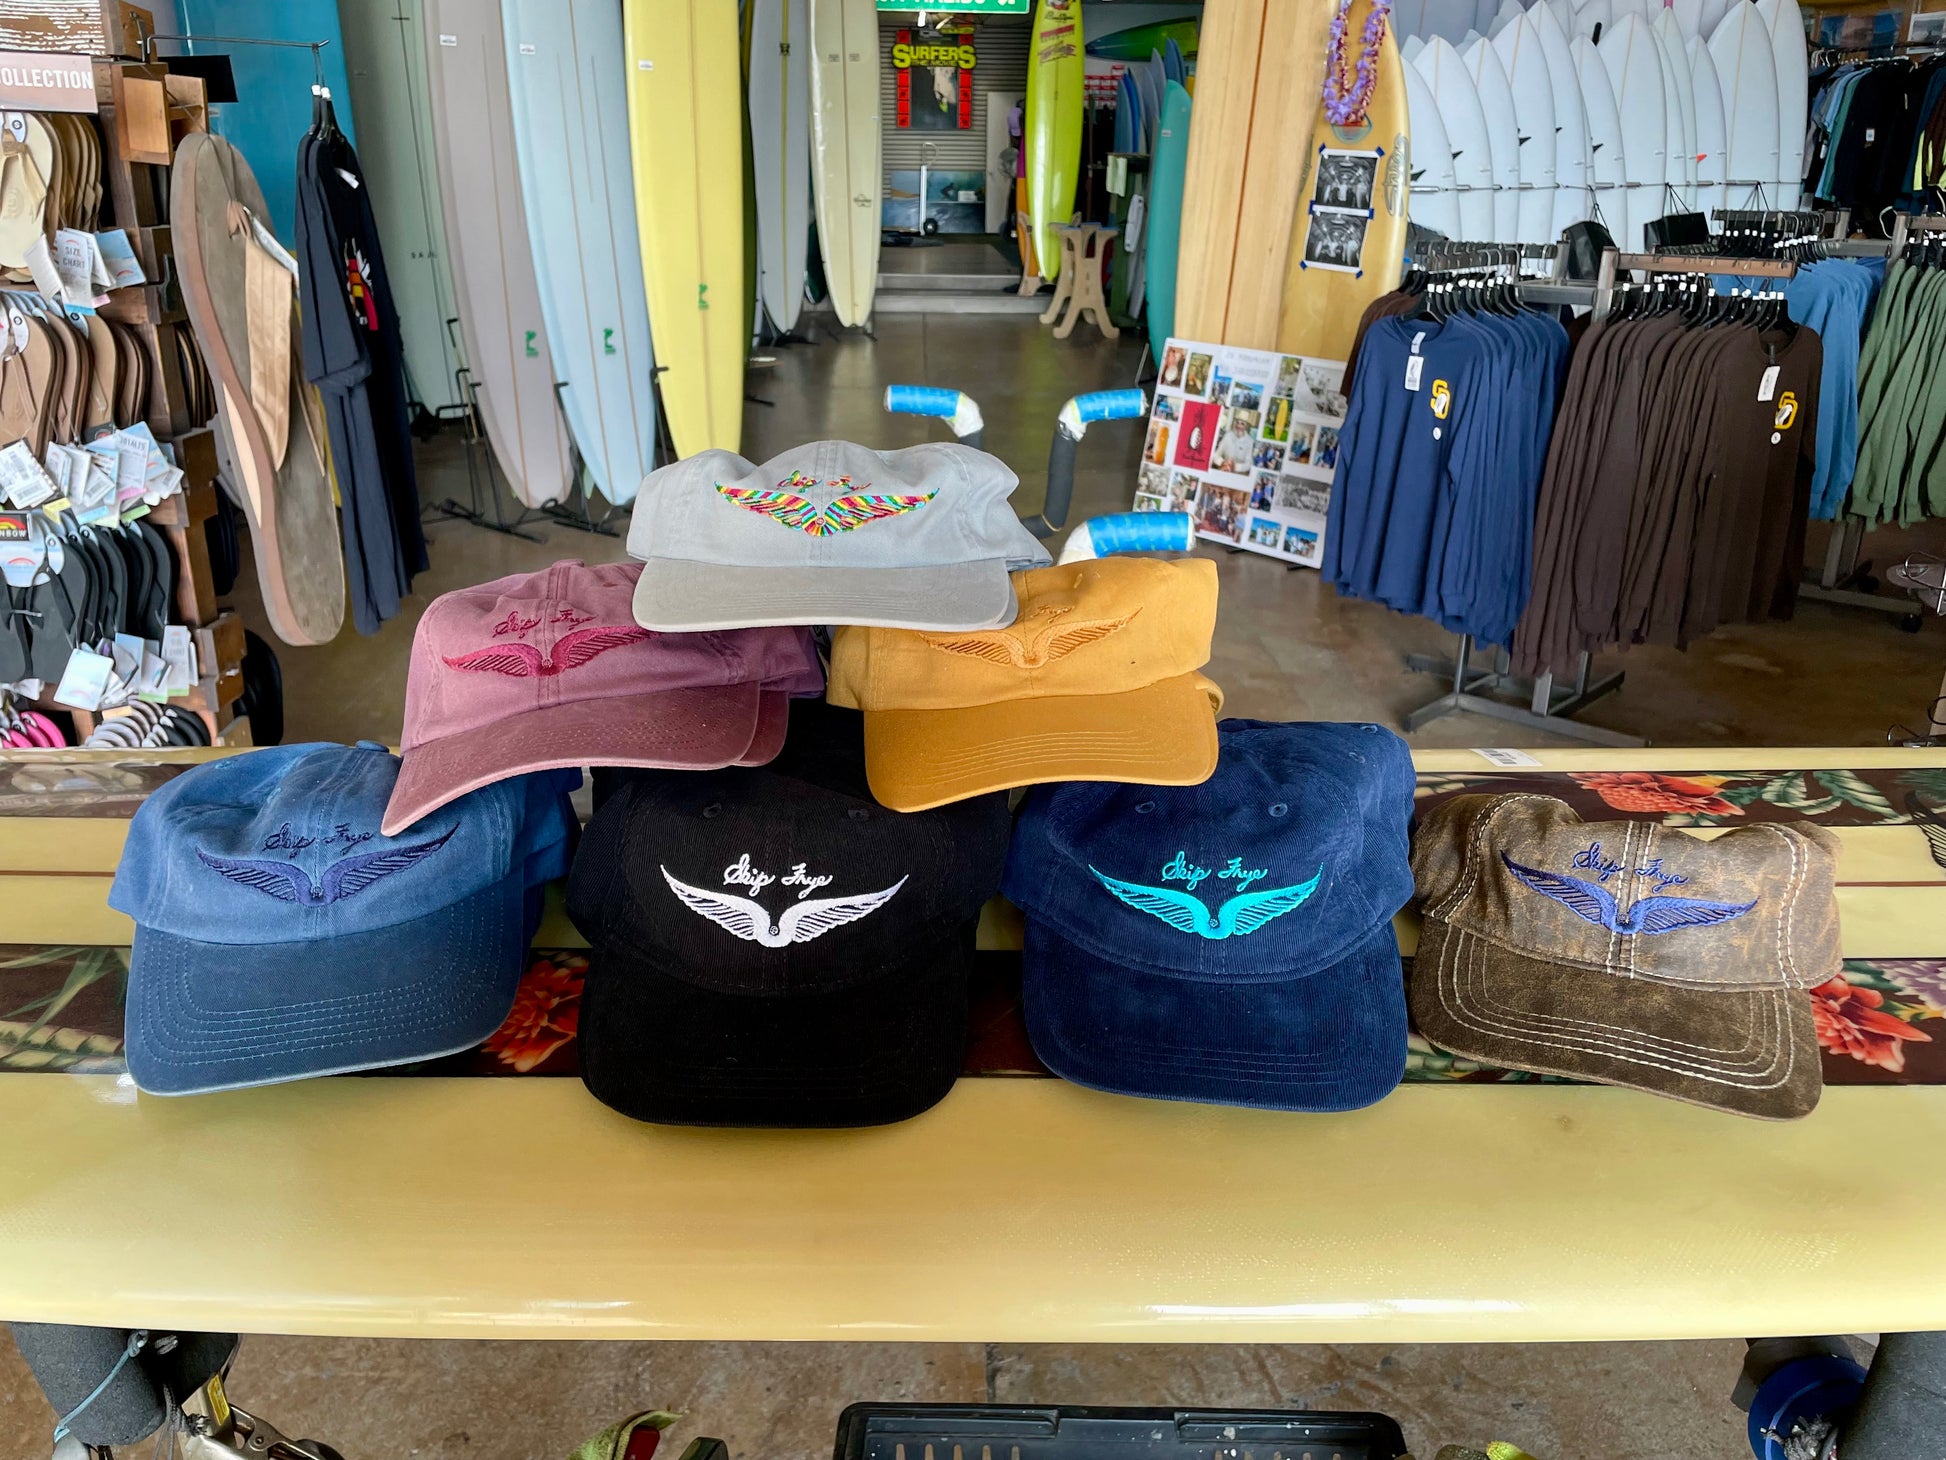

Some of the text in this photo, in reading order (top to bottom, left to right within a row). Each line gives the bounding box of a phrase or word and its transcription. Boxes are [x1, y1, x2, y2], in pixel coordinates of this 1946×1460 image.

[892, 43, 977, 69] SURFERS
[0, 67, 93, 89] OLLECTION
[62, 257, 85, 269] CHART
[65, 246, 81, 257] SIZE
[492, 610, 542, 639] Skip
[262, 821, 316, 859] Skip
[1161, 850, 1269, 892] Skip Frye
[1571, 841, 1627, 882] Skip
[723, 853, 834, 900] Skip Frye
